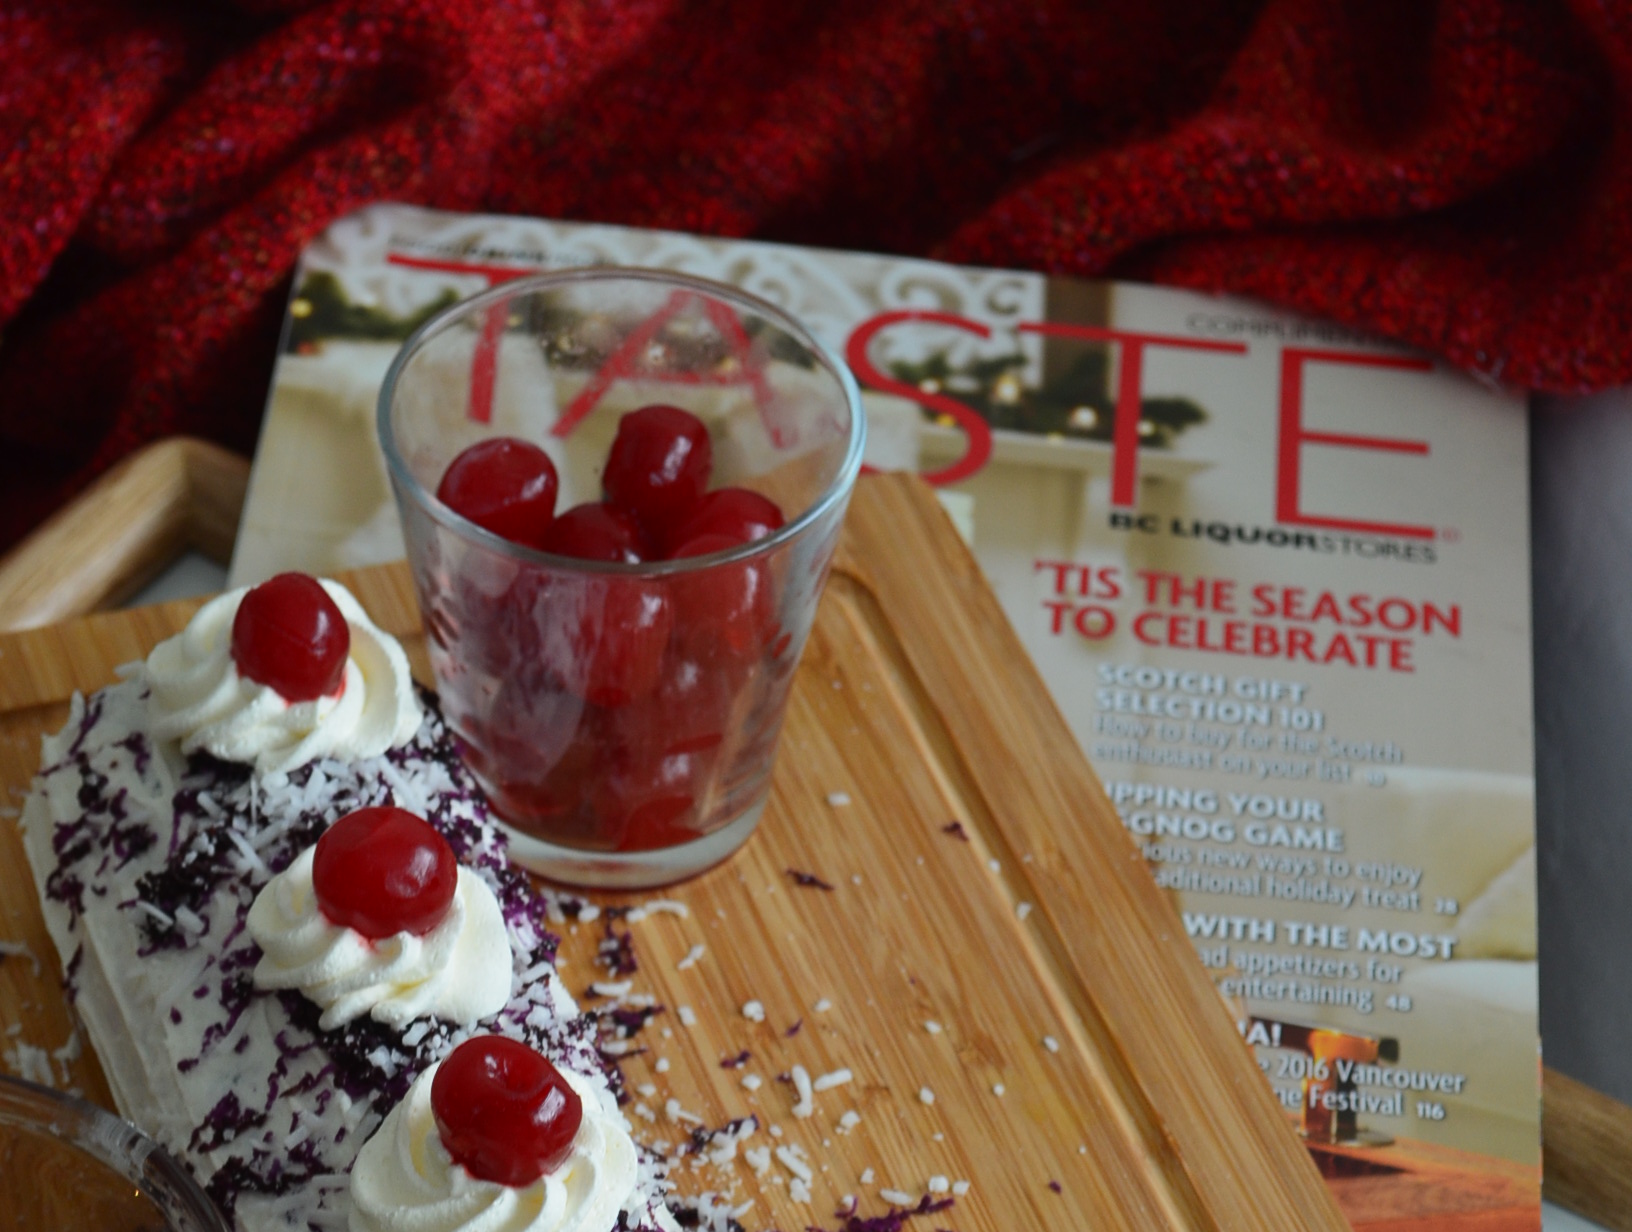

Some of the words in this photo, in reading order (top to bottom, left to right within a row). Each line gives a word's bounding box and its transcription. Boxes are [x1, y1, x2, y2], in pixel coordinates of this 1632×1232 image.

[387, 252, 1437, 540] TASTE
[1109, 512, 1158, 534] BC
[1136, 569, 1238, 614] THE
[1252, 584, 1462, 638] SEASON
[1042, 598, 1117, 642] TO
[1131, 611, 1416, 673] CELEBRATE
[1098, 664, 1227, 696] SCOTCH
[1234, 677, 1309, 703] GIFT
[1096, 690, 1272, 728] SELECTION
[1229, 793, 1325, 822] YOUR
[1243, 823, 1345, 852] GAME
[1198, 849, 1251, 868] new
[1256, 853, 1317, 877] ways
[1324, 856, 1351, 877] to
[1356, 861, 1422, 888] enjoy
[1267, 875, 1355, 909] holiday
[1362, 886, 1420, 911] treat
[1182, 911, 1276, 944] WITH
[1284, 921, 1349, 949] THE
[1357, 927, 1458, 960] MOST
[1234, 951, 1361, 980] appetizers
[1366, 956, 1403, 982] for
[1219, 976, 1374, 1014] entertaining
[1277, 1053, 1329, 1081] 2016
[1336, 1057, 1465, 1093] Vancouver
[1309, 1083, 1404, 1116] Festival
